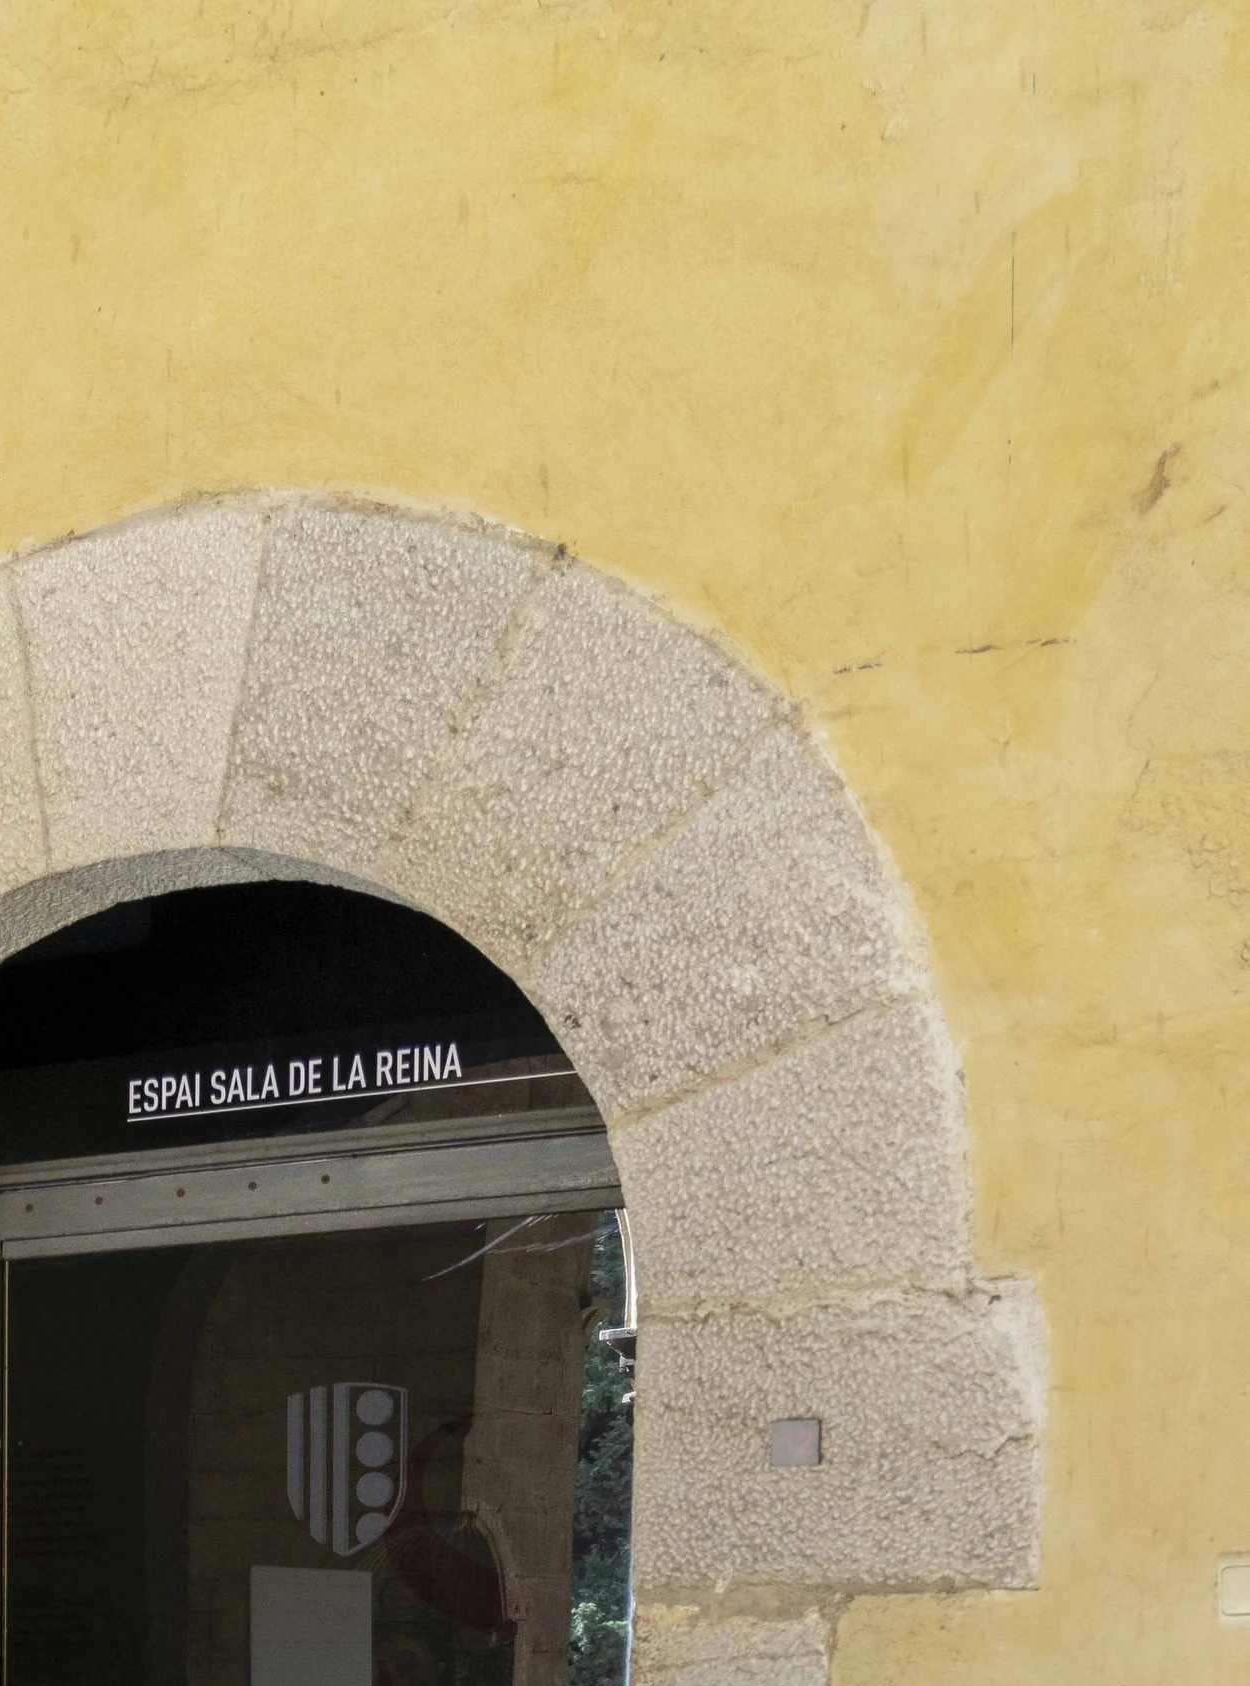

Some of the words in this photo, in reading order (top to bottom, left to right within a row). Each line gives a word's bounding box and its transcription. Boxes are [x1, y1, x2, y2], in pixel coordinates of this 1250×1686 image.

[129, 1073, 201, 1114] ESPAI
[210, 1064, 280, 1105] SALA
[289, 1059, 323, 1096] DE
[333, 1054, 366, 1091] LA
[376, 1043, 463, 1087] REINA
